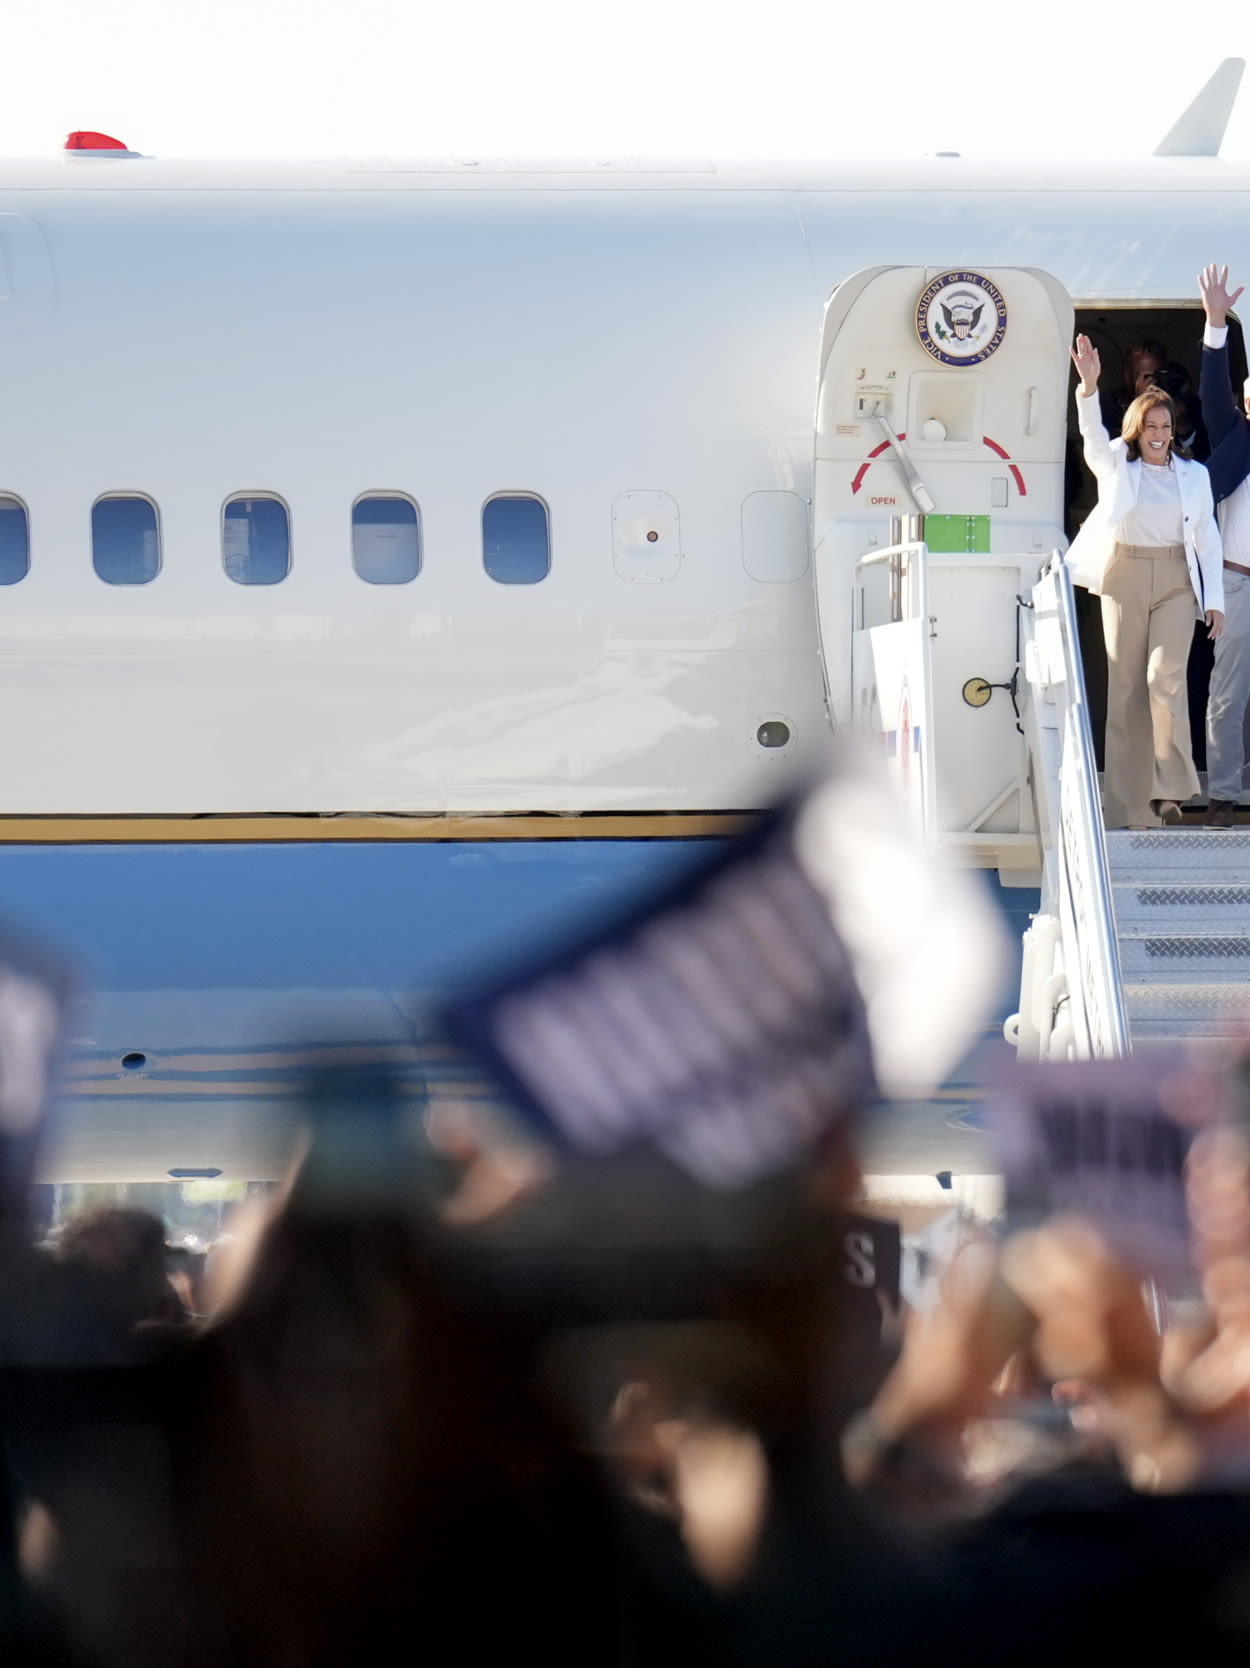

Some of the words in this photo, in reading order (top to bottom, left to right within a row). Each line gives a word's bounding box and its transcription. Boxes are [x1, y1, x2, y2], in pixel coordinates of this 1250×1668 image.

[948, 274, 960, 282] OF
[962, 273, 978, 283] THE
[918, 280, 944, 333] PRESIDENT
[981, 279, 1006, 317] UNITED
[922, 336, 942, 360] VICE
[978, 326, 1005, 361] STATES
[871, 497, 896, 505] OPEN
